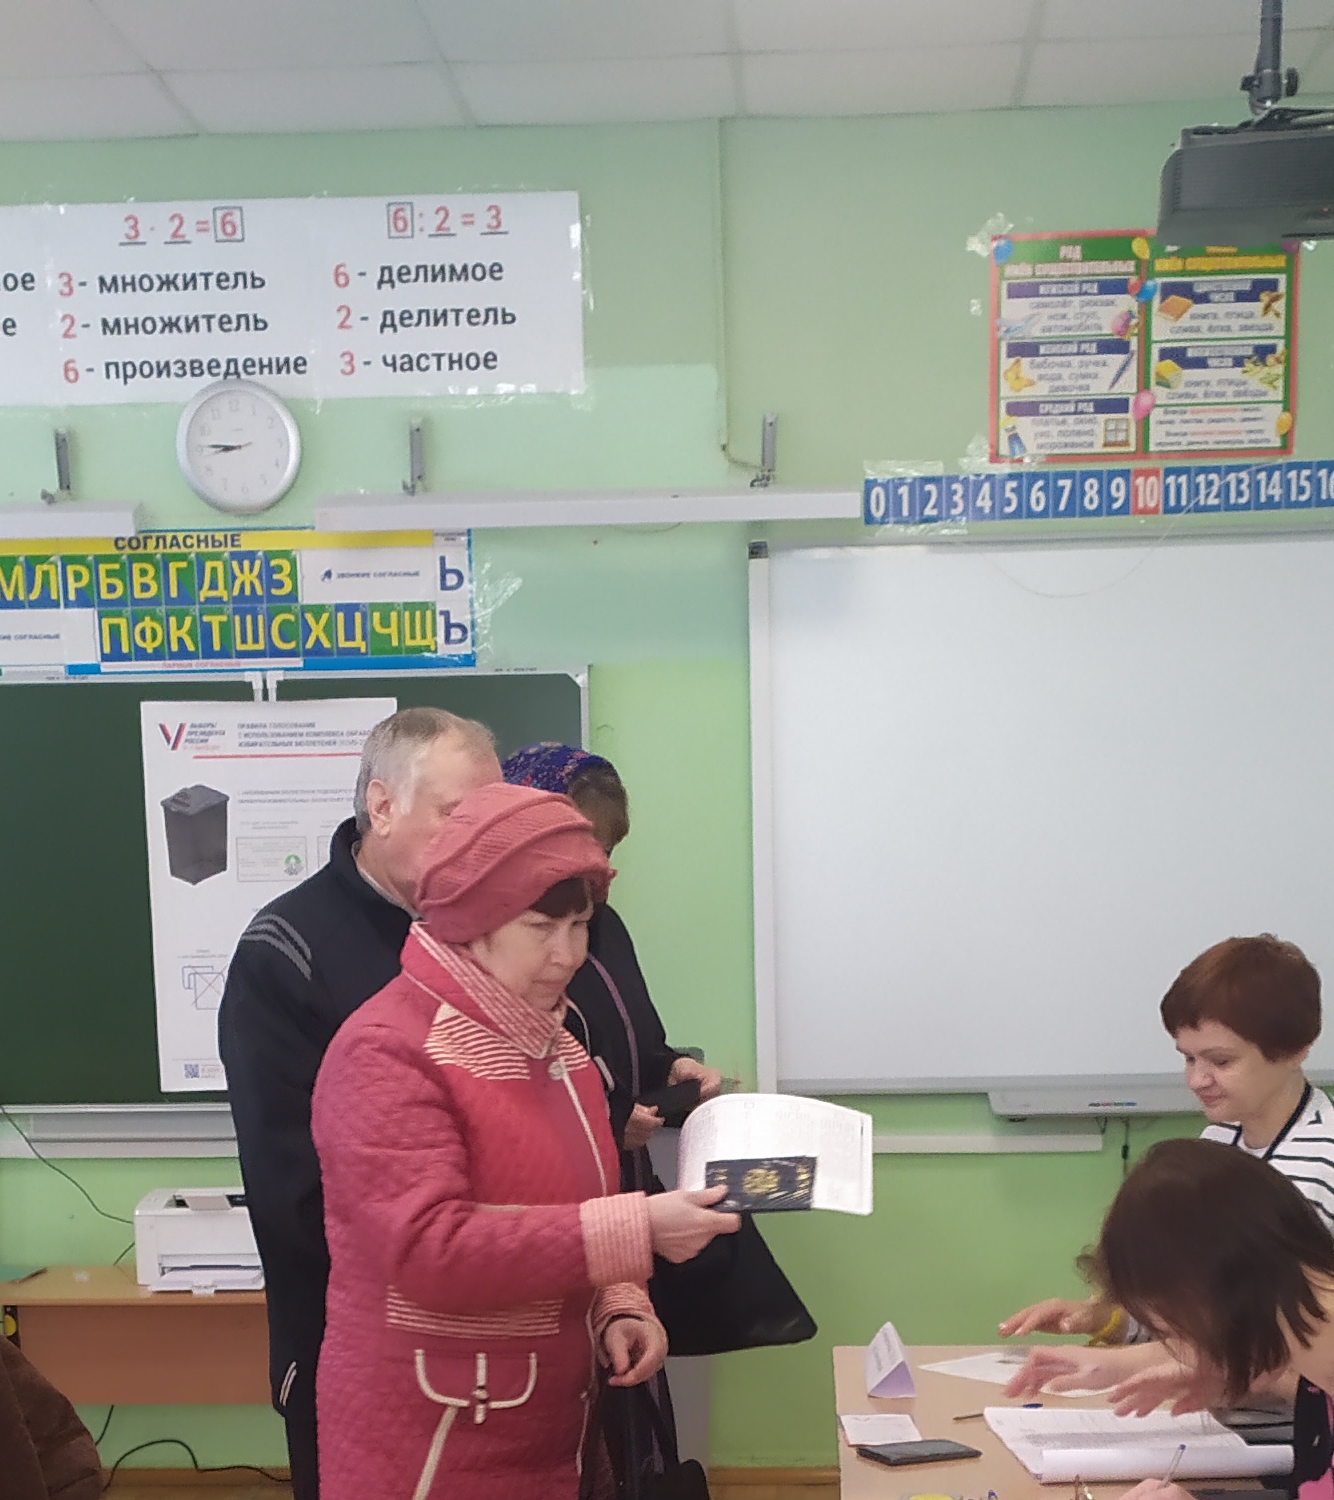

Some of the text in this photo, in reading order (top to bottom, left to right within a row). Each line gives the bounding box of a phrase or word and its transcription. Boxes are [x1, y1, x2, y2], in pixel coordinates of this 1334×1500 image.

[97, 267, 266, 295] множитель
[376, 258, 505, 288] делимое
[100, 311, 269, 337] множитель
[378, 302, 517, 333] делитель
[104, 353, 309, 386] произведение
[381, 347, 499, 374] частное
[870, 486, 886, 518] 0
[898, 485, 909, 517] 1
[924, 483, 938, 516] 2
[950, 483, 964, 515] 3
[976, 482, 992, 513] 4
[1003, 481, 1017, 513] 5
[1030, 480, 1046, 511] 6
[1057, 479, 1072, 510] 7
[1083, 478, 1099, 510] 8
[1110, 477, 1126, 509] 9
[1135, 475, 1159, 508] 10
[1166, 474, 1187, 507] 11
[1195, 473, 1219, 505] 12
[1227, 472, 1250, 504] 13
[1257, 470, 1282, 503] 14
[1288, 469, 1311, 501] 15
[113, 533, 242, 551] СОГЛАСНЫЕ
